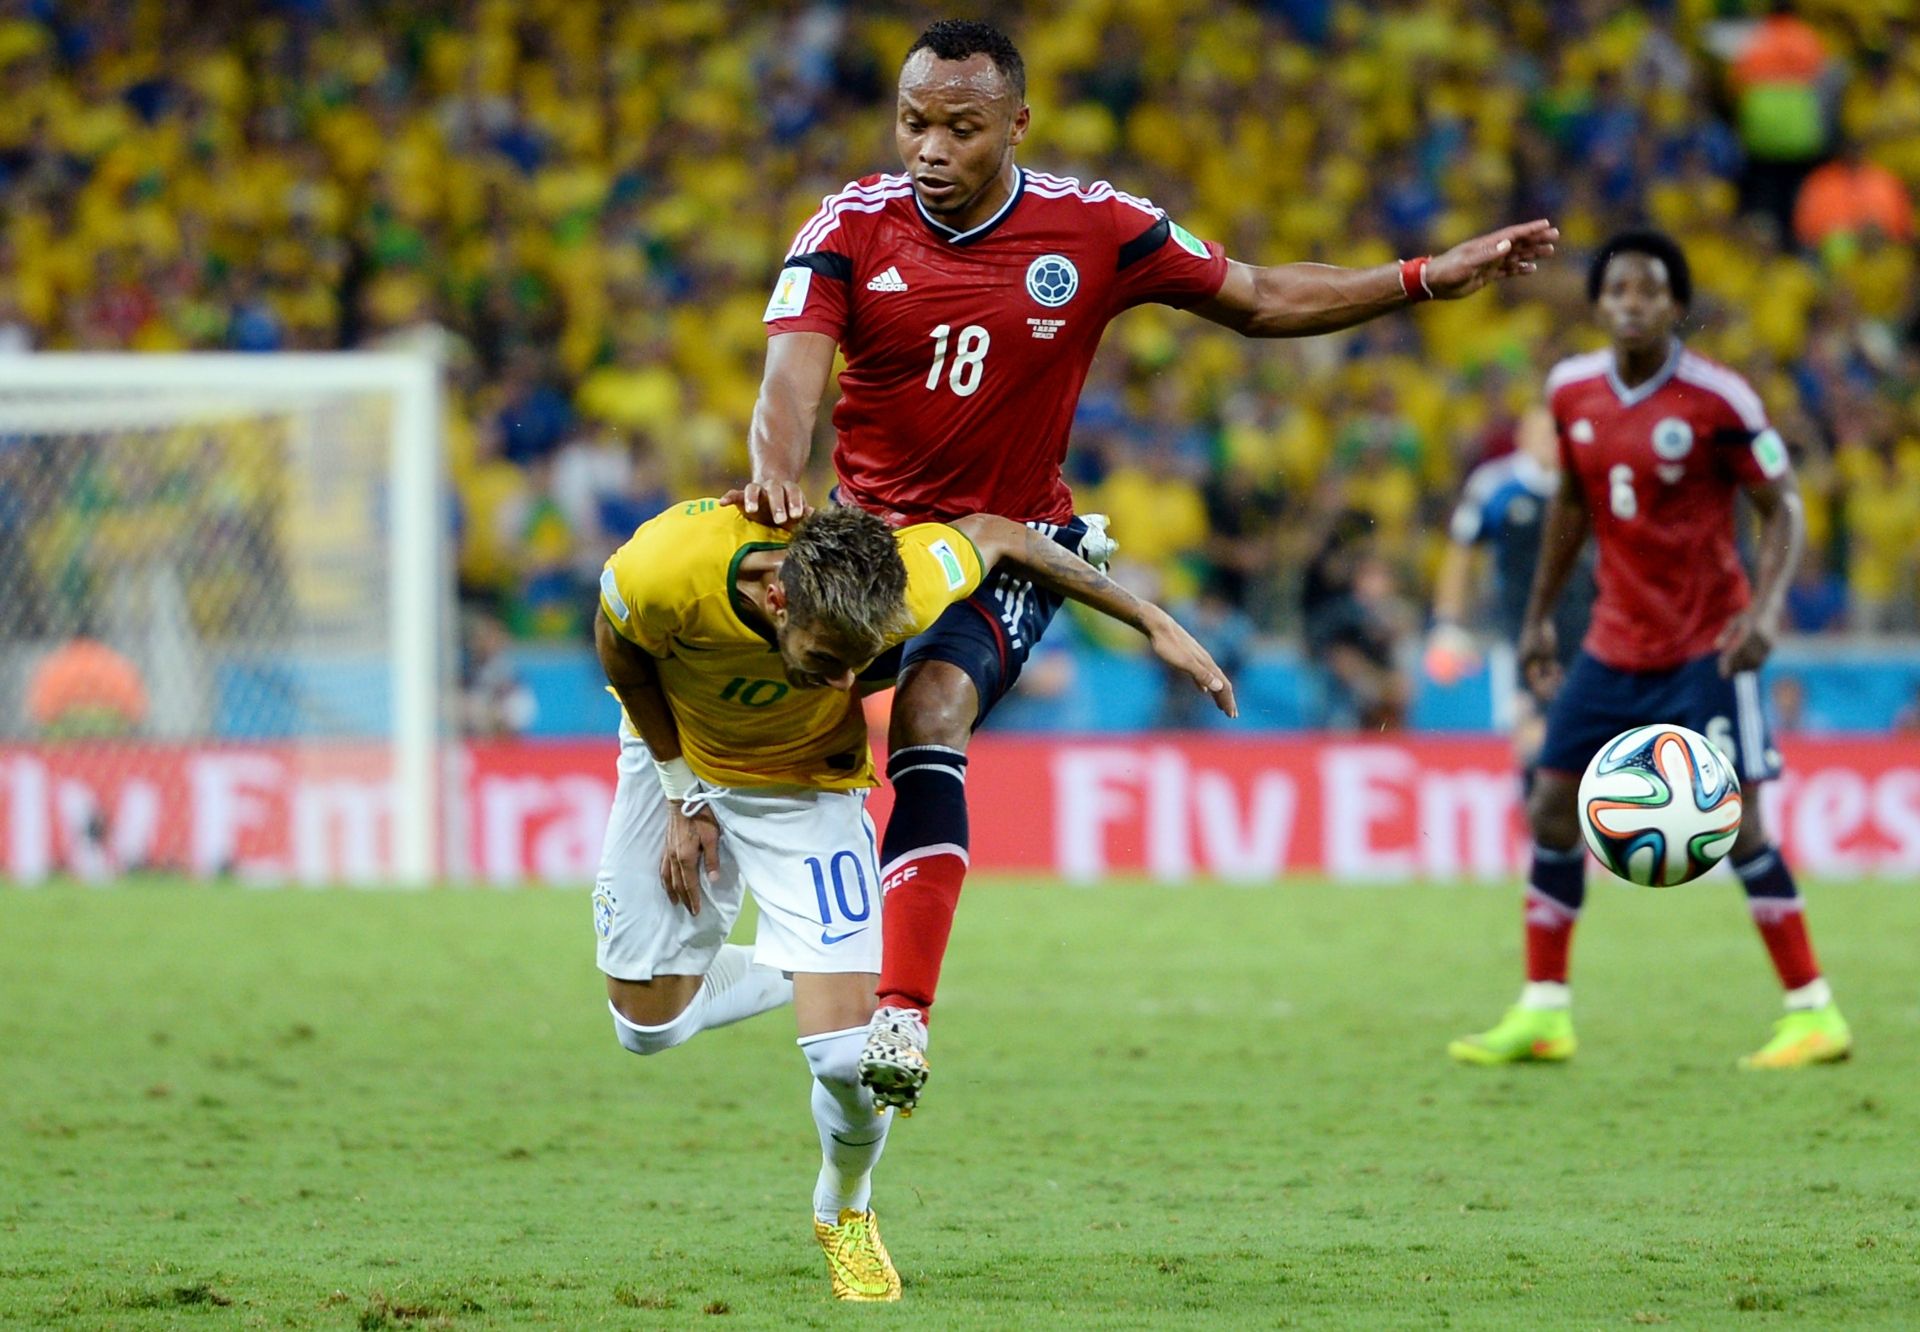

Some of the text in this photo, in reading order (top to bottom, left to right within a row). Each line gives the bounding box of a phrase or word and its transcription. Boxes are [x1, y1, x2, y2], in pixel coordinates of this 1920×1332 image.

[925, 324, 990, 397] 18
[1608, 463, 1637, 521] 6
[719, 677, 789, 707] 10
[188, 751, 607, 887] Emira
[804, 850, 871, 925] 10
[882, 866, 918, 897] FCF
